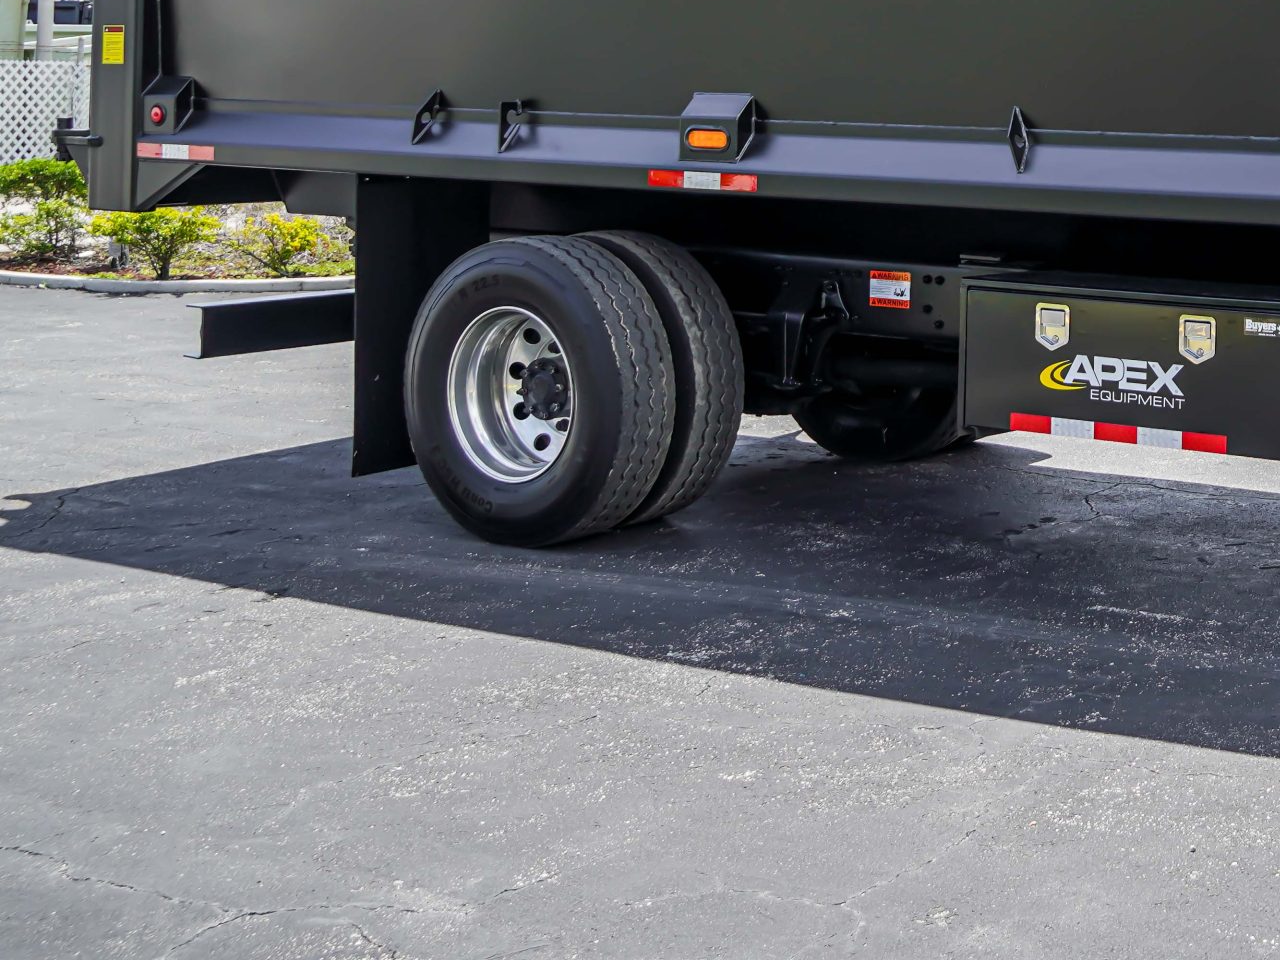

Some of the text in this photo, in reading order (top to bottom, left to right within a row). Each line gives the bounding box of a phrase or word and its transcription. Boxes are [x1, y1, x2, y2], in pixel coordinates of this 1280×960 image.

[877, 297, 909, 307] WARNING
[1245, 318, 1277, 333] Buyers
[1063, 354, 1185, 397] APEX
[1090, 389, 1186, 410] EQUIPMENT
